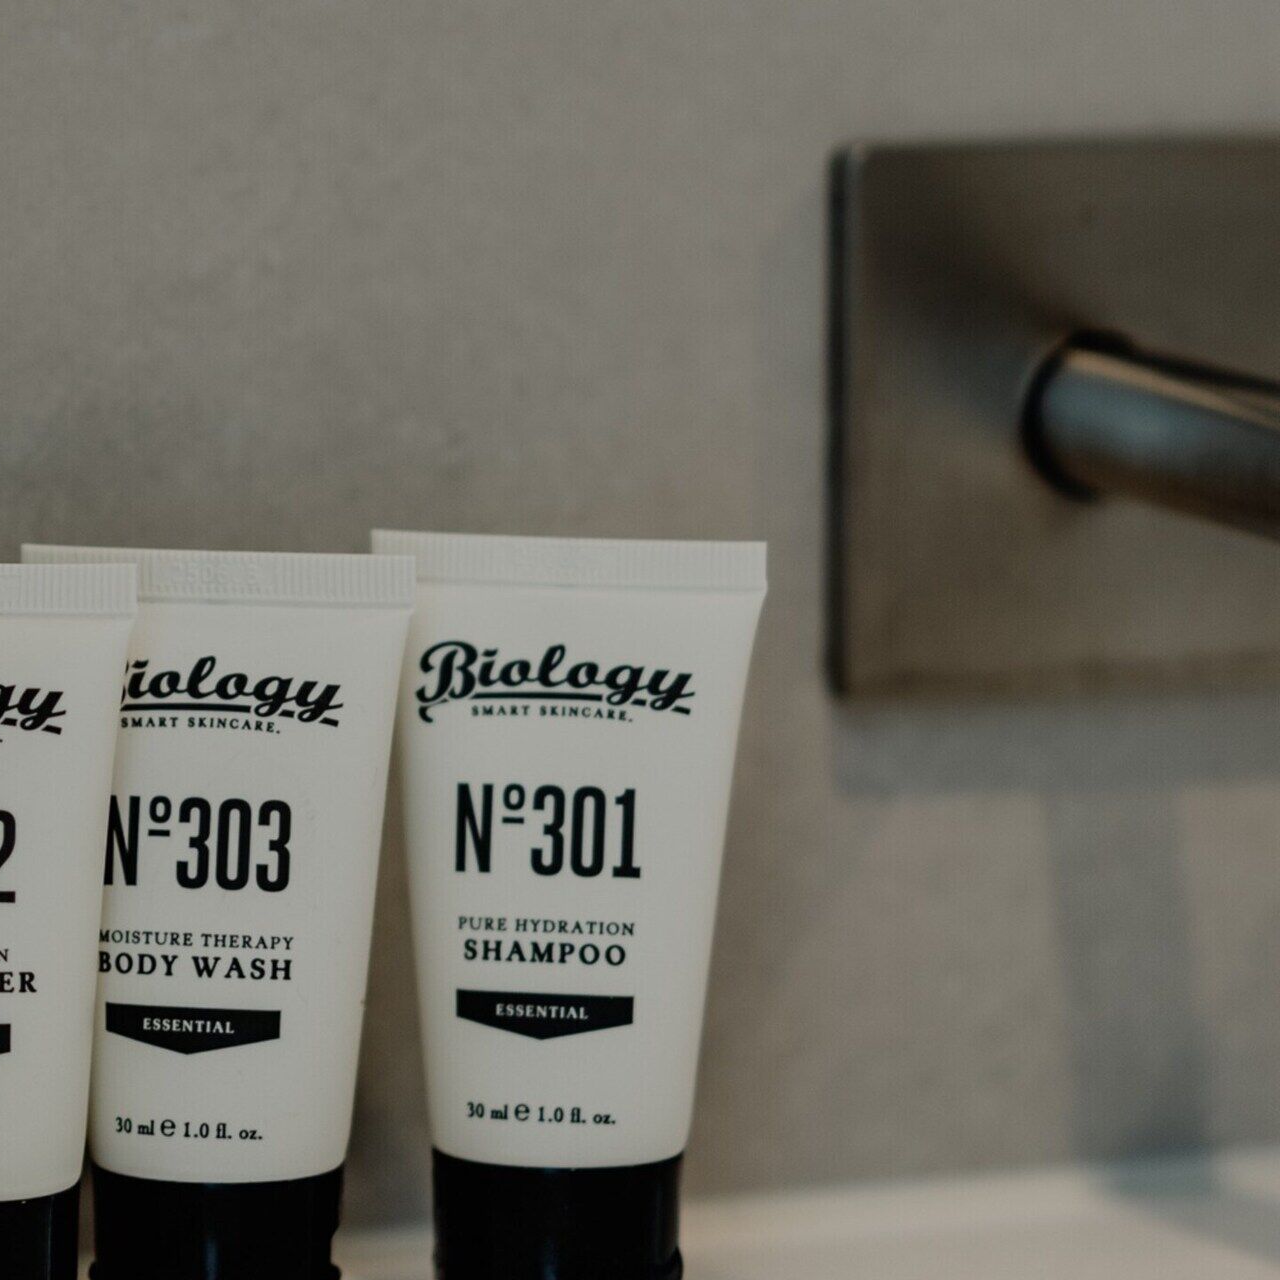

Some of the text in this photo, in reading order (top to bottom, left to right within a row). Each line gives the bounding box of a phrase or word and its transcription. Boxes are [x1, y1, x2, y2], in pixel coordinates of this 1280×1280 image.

[416, 640, 696, 714] Biology
[121, 656, 344, 728] iology
[471, 704, 633, 722] SMART SKINCARE.
[121, 717, 281, 734] SMART SKINCARE.
[457, 916, 635, 936] PURE HYDRATION
[99, 929, 294, 950] MOISTURE THERAPY
[464, 938, 626, 966] SHAMPOO
[98, 951, 293, 980] BODY WASH
[495, 1003, 589, 1020] ESSENTIAL
[143, 1018, 235, 1035] ESSENTIAL
[466, 1101, 484, 1118] 30
[490, 1104, 508, 1120] ml
[537, 1106, 564, 1123] 1.0
[570, 1106, 585, 1124] fl.
[592, 1114, 616, 1125] oz.
[115, 1117, 132, 1133] 30
[137, 1120, 155, 1137] ml
[184, 1122, 210, 1139] 1.0
[216, 1122, 233, 1140] fl.
[238, 1129, 263, 1141] oz.
